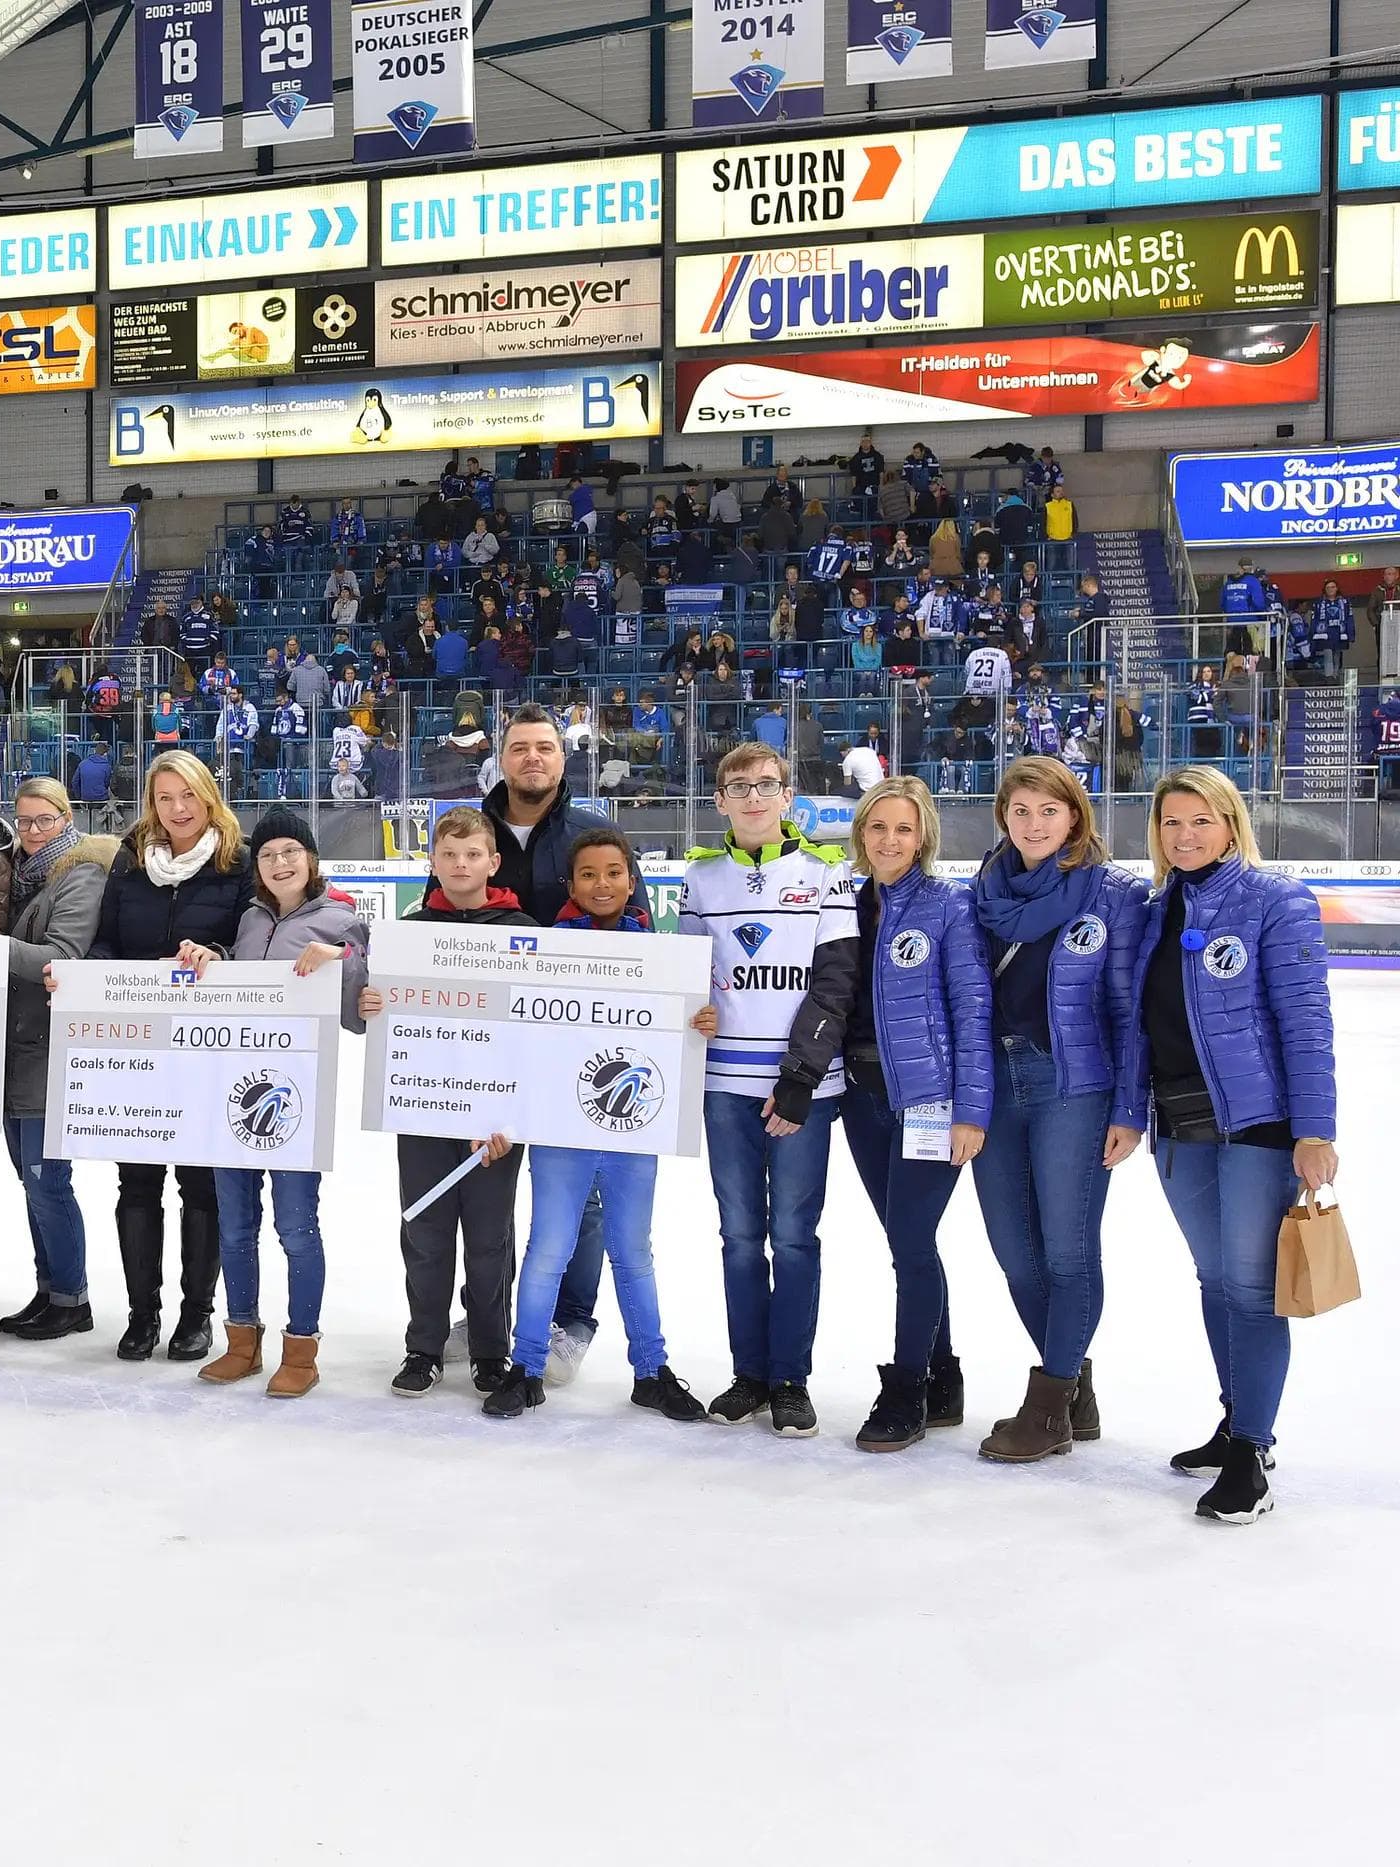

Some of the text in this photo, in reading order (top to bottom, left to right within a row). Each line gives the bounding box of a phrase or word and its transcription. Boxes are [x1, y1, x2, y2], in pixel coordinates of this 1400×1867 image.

[264, 6, 308, 26] WAITE
[362, 7, 461, 31] DEUTSCHER
[164, 21, 193, 39] AST
[721, 13, 794, 42] 2014
[260, 24, 312, 73] 29
[355, 27, 469, 53] POKALSIEGER
[160, 39, 197, 84] 18
[378, 52, 446, 81] 2005
[272, 80, 302, 91] ERC
[1019, 123, 1284, 192] DAS BESTE
[712, 149, 844, 192] SATURN
[391, 178, 661, 243] EIN TREFFER!
[751, 187, 844, 226] CARD
[124, 212, 293, 266] EINKAUF
[755, 247, 843, 275] MÖBEL
[1247, 284, 1256, 292] in
[1258, 282, 1304, 291] Ingolstadt
[391, 279, 631, 320] schmidmeyer
[748, 260, 948, 340] gruber
[1235, 293, 1303, 303] www.mcdonalds.de
[114, 301, 188, 317] DER EINFACHSTE
[114, 315, 156, 327] WEG ZUM
[391, 318, 546, 340] Kies Erdbau Abbruch
[874, 322, 949, 332] Gaimersheim
[114, 325, 167, 337] NEUEN BAD
[312, 341, 358, 353] elements
[497, 332, 643, 352] www.schmidmeyer.net
[902, 354, 1011, 373] IT-Helden für
[21, 371, 81, 382] STAPLER
[978, 372, 1098, 391] Unternehmen
[391, 385, 574, 405] Training, Support & Development
[190, 399, 347, 418] Linux/Open Source Consulting,
[698, 405, 791, 423] SysTec
[433, 413, 545, 429] info@b-systems.de
[210, 427, 312, 442] www.b-systems.de
[752, 438, 764, 462] F
[1281, 515, 1397, 534] INGOLSTADT
[974, 659, 994, 677] 23
[1301, 865, 1332, 875] Audi
[68, 1022, 292, 1048] SPENDE 4.000 Euro
[390, 1073, 517, 1093] Caritas-Kinderdorf
[68, 1103, 182, 1118] Elisa e.V. Verein zur
[389, 1095, 471, 1113] Marienstein
[66, 1124, 176, 1140] Familiennachsorge
